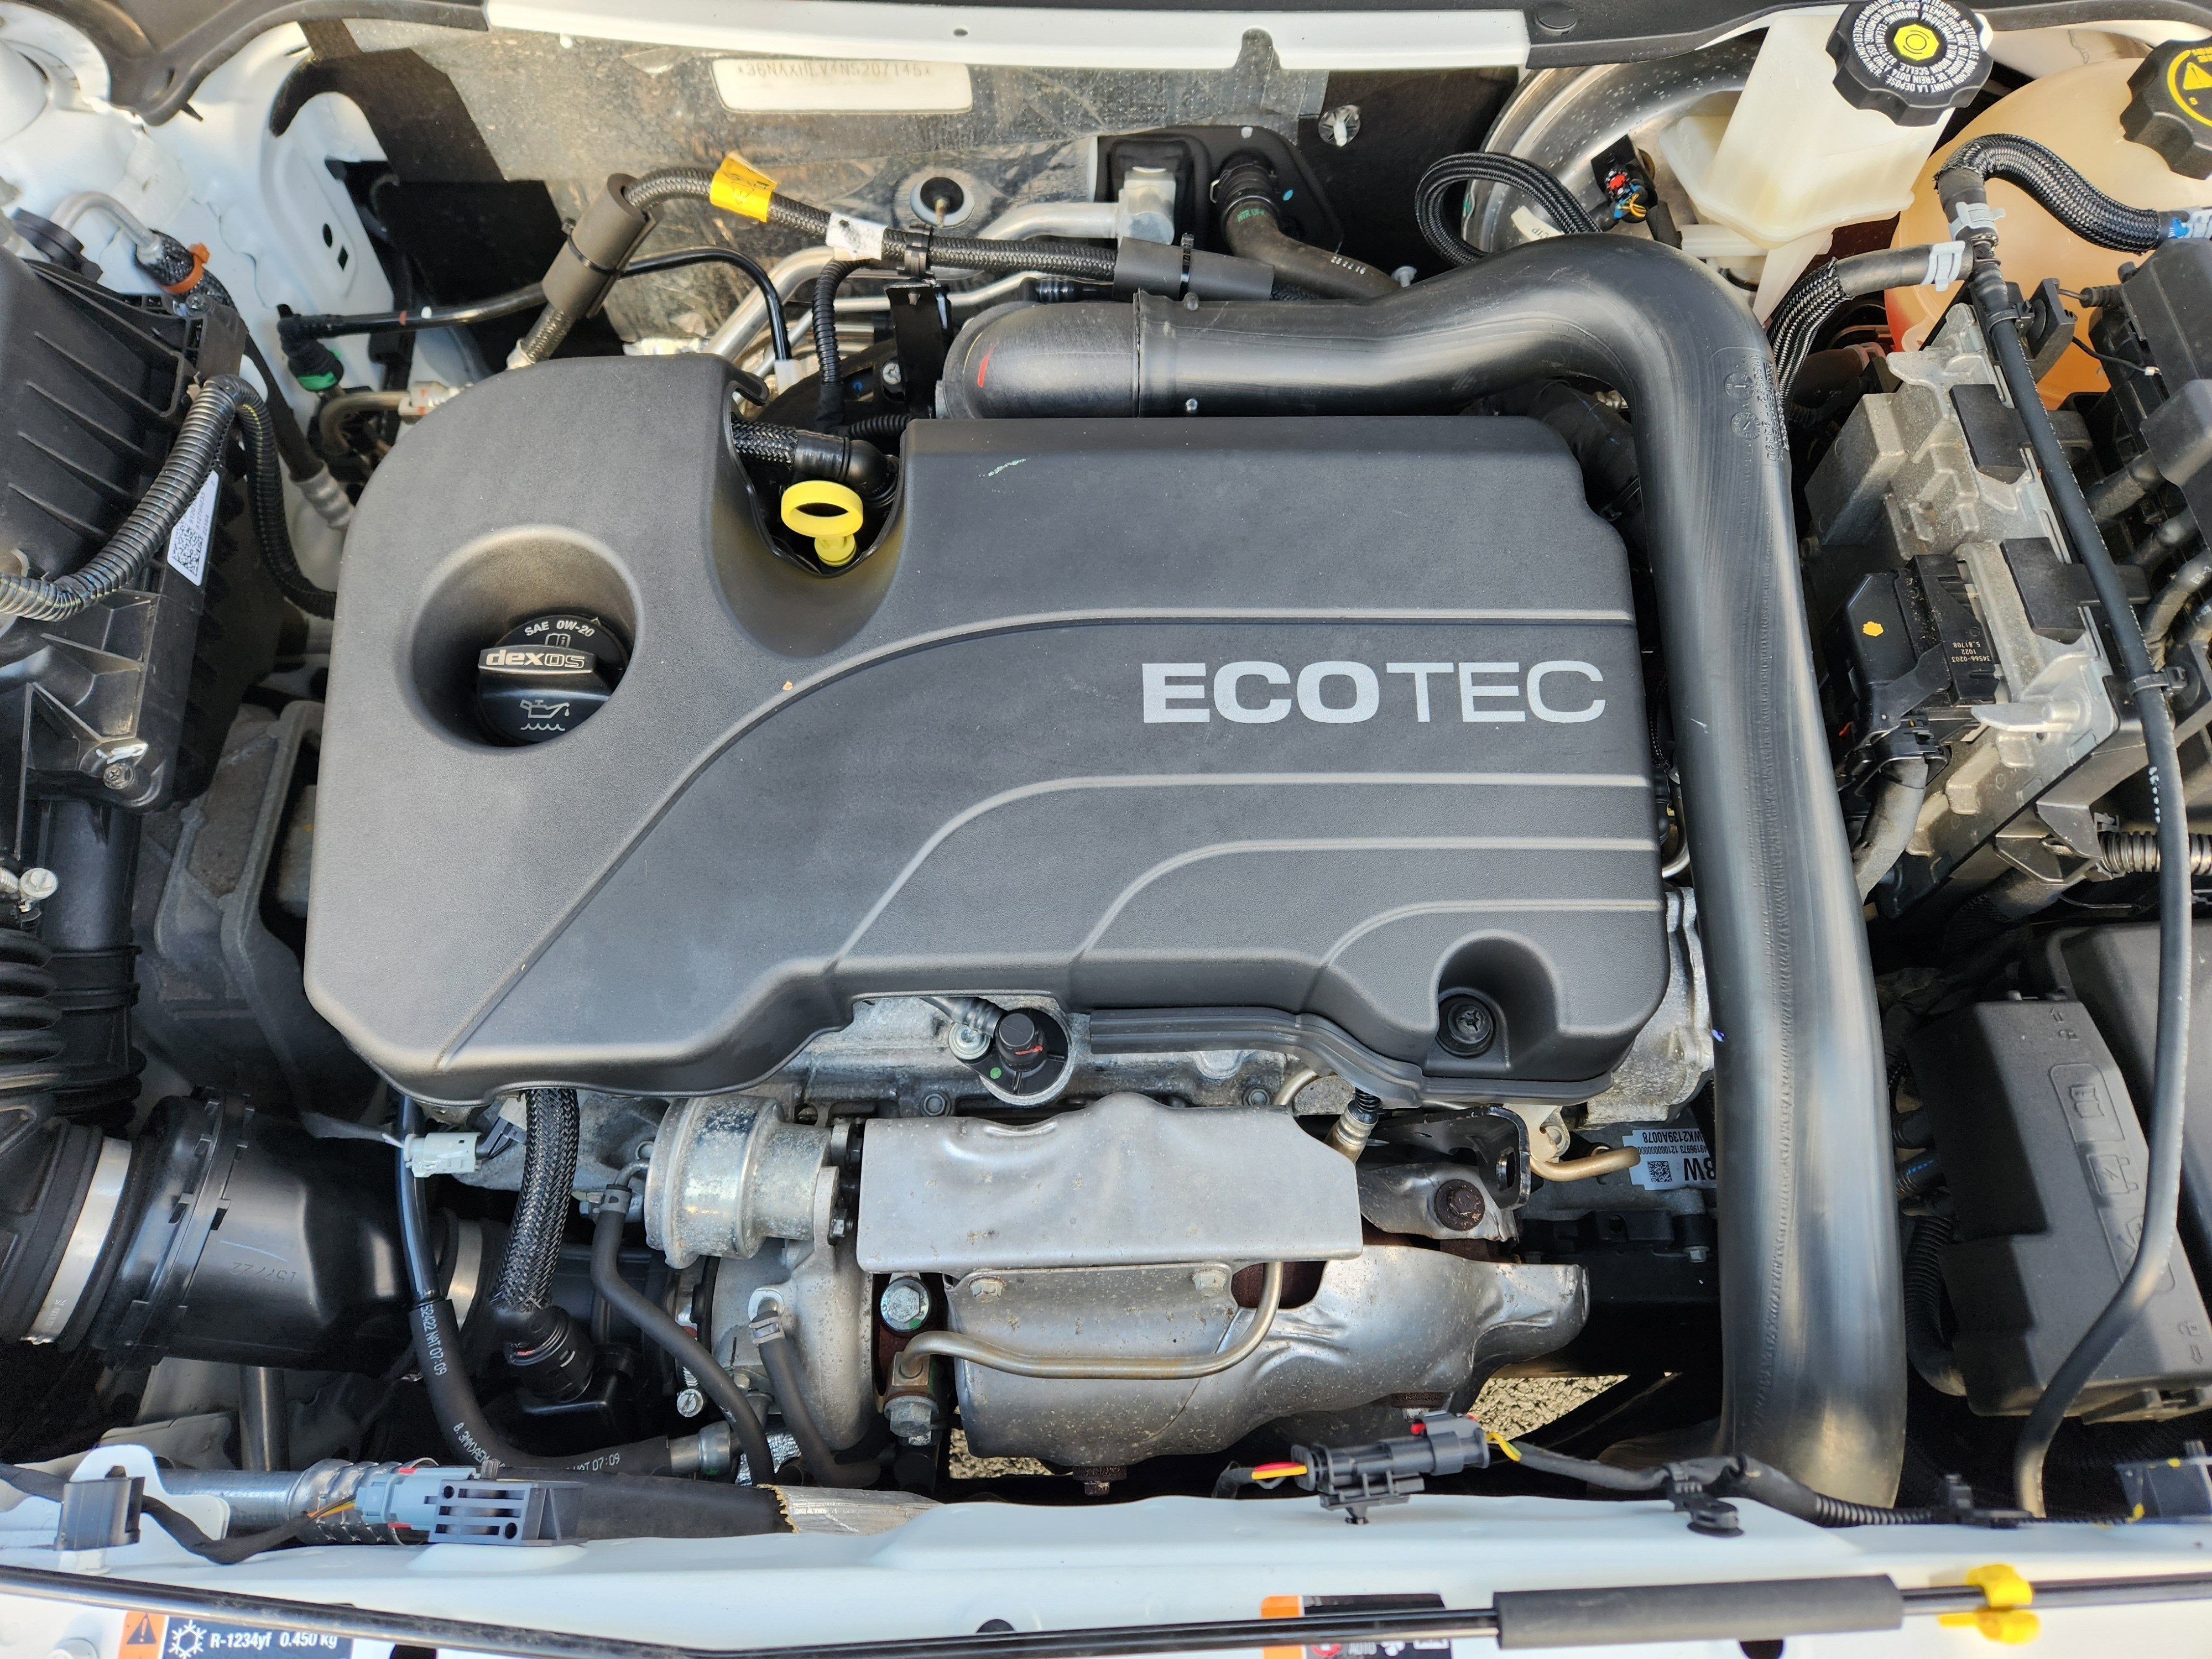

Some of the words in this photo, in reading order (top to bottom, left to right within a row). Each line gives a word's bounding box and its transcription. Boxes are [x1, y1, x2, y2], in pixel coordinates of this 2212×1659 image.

[1861, 1, 1881, 17] FROM
[1878, 3, 1905, 17] BEFORE
[1921, 0, 1961, 20] TENTION:
[1853, 19, 1866, 43] SEALED
[1875, 23, 1888, 44] CLEAN
[1955, 33, 1969, 46] QUE
[1866, 45, 1879, 58] USE
[1877, 44, 1897, 66] FILLER
[1969, 51, 1979, 60] LE
[1873, 56, 1892, 72] ONLY
[1929, 58, 1953, 74] BIDON
[1945, 56, 1967, 77] LIQUIDE
[1952, 59, 1978, 85] BOUCHON
[1891, 69, 1911, 82] DOT4
[1912, 75, 1936, 84] FREIN
[1935, 72, 1948, 82] DE
[1917, 85, 1928, 93] LA
[1929, 80, 1953, 93] AVANT
[524, 621, 550, 636] SAE
[556, 620, 595, 637] 0W-20
[486, 649, 585, 668] dexos
[1142, 660, 1606, 723] ECOTEC
[426, 1330, 441, 1348] NAT
[430, 1347, 447, 1375] 07:09
[592, 1453, 620, 1471] 07:09
[210, 1632, 272, 1651] R-1234yf
[279, 1632, 317, 1647] 0.450
[319, 1635, 338, 1650] kg
